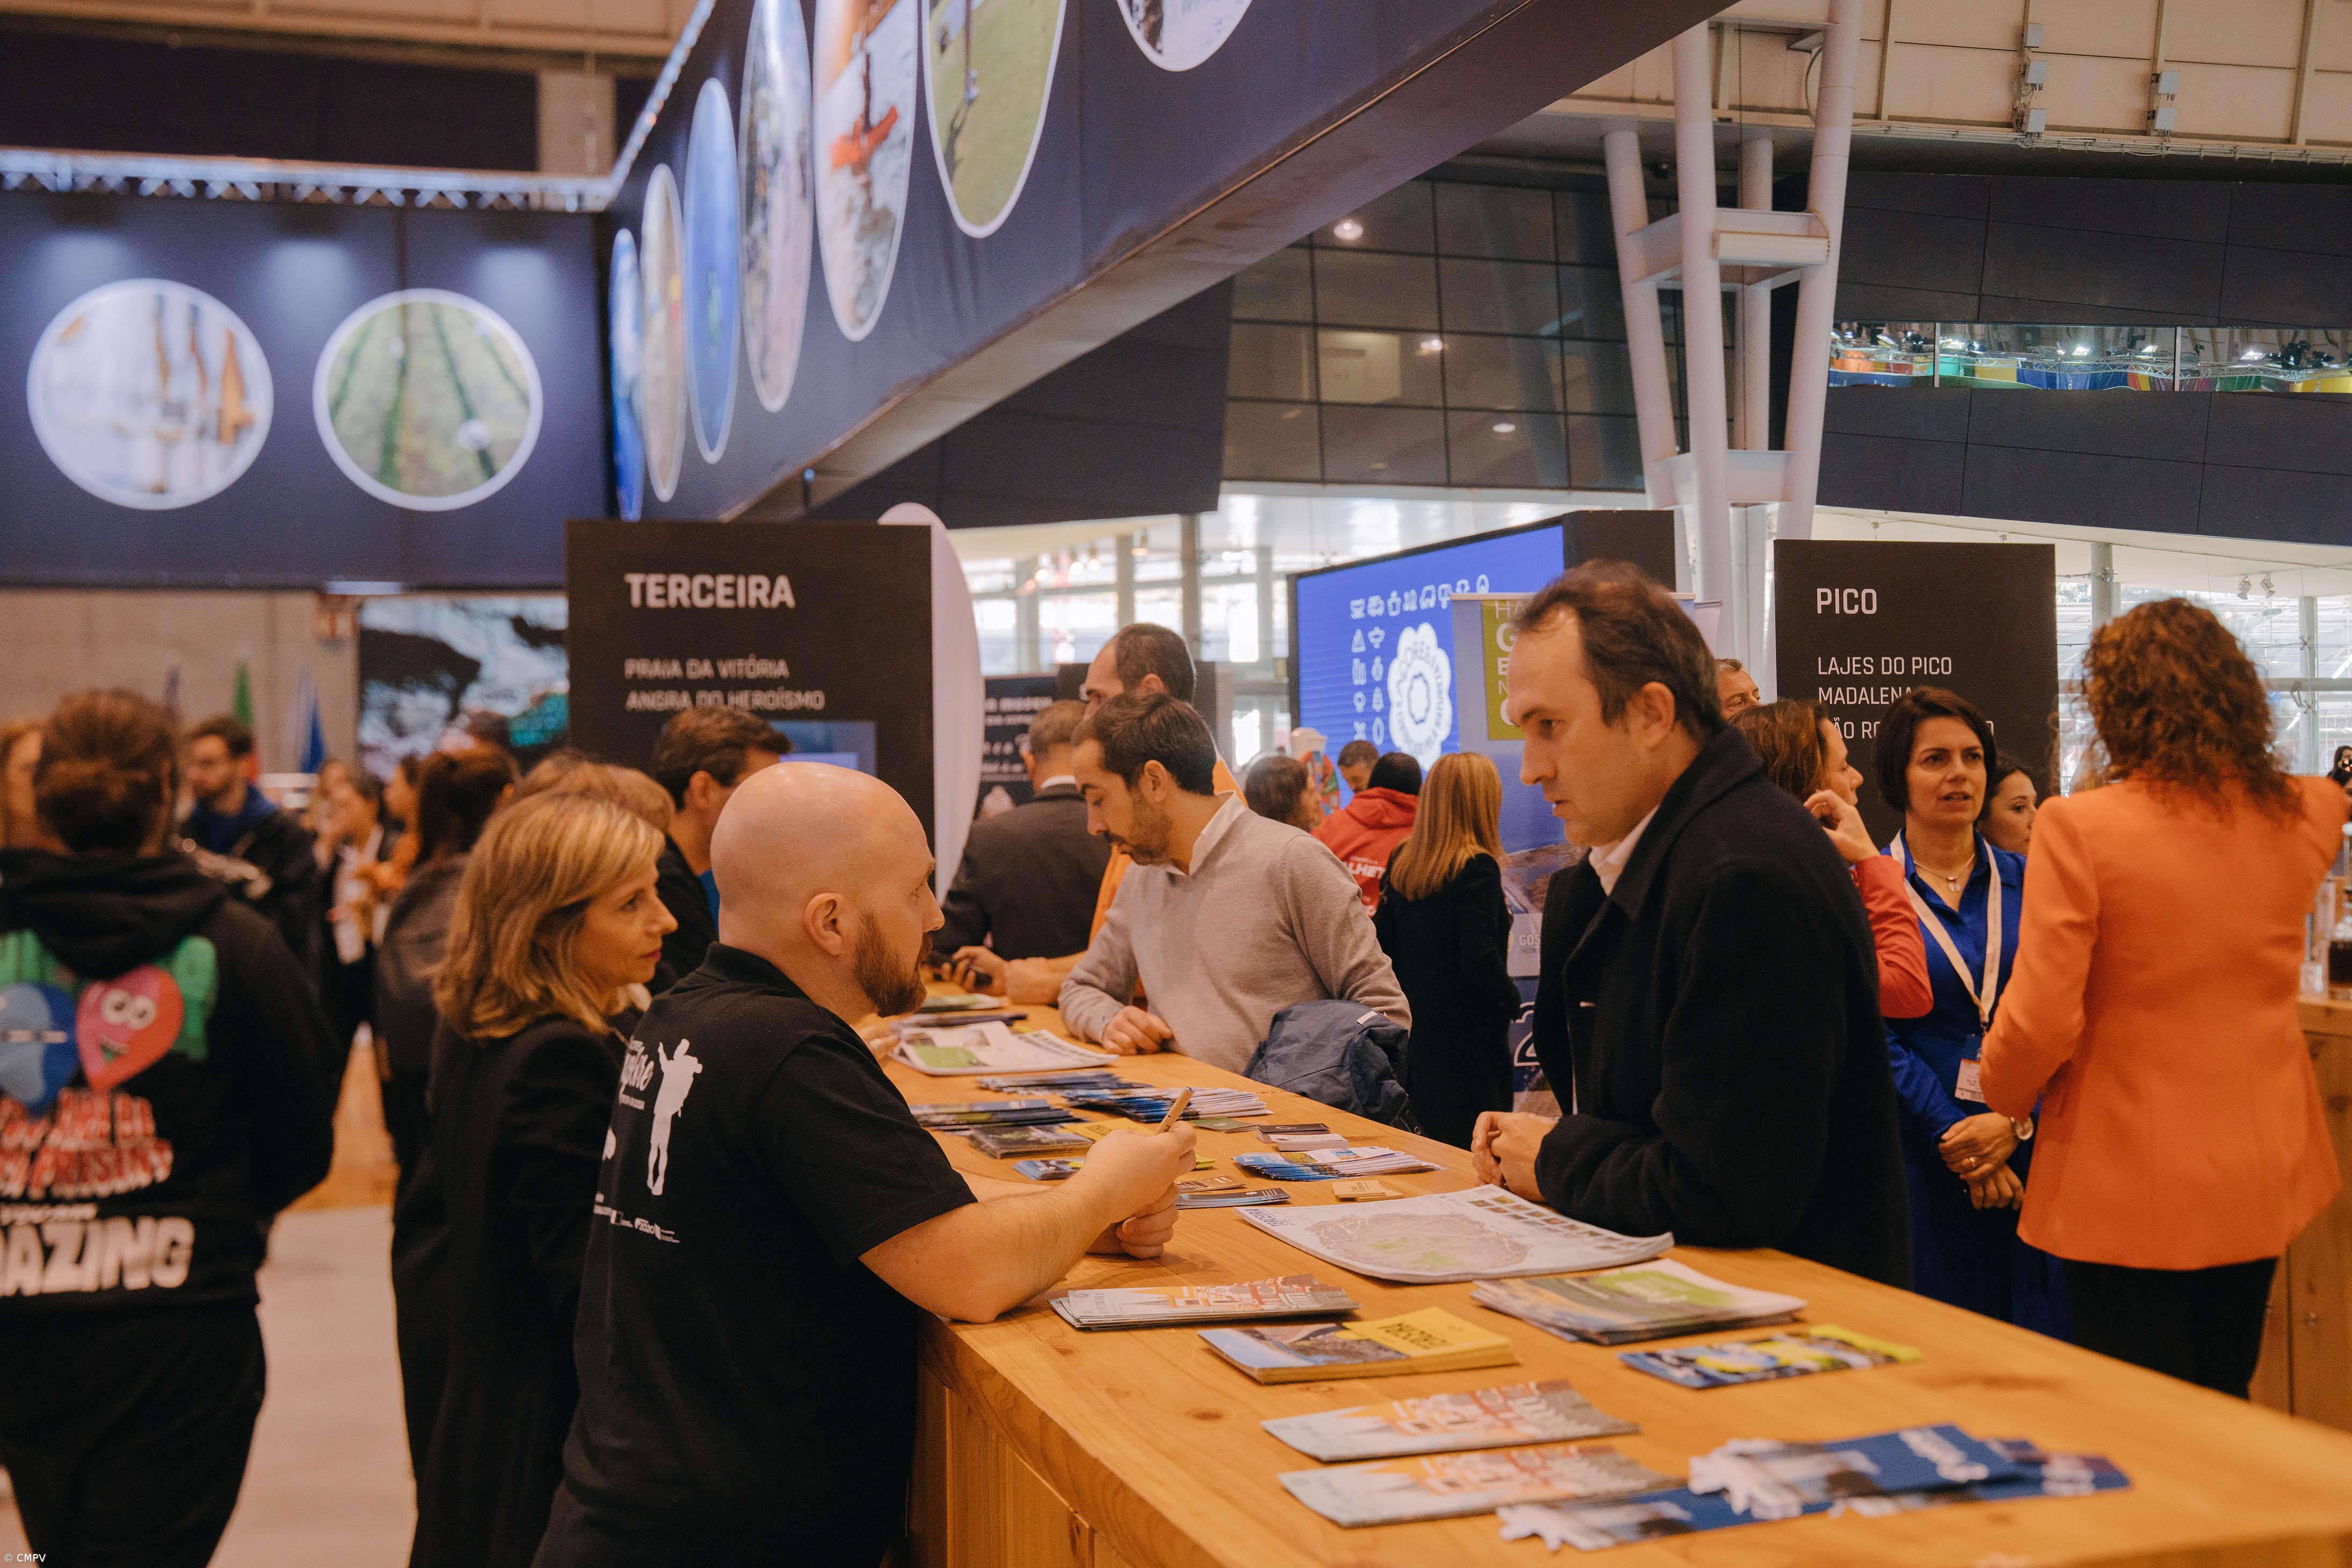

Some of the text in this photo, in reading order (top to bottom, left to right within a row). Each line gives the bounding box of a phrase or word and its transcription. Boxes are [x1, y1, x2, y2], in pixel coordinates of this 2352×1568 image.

[623, 572, 796, 608] TERCEIRA
[1817, 588, 1877, 614] PICO
[624, 654, 790, 679] PRAIA DA VITÓRIA
[1818, 657, 1952, 675] LAJES DO PICO
[625, 685, 825, 712] ANGRA DO HEROÍSMO
[1833, 717, 1855, 739] ÃO
[0, 1216, 195, 1297] AZING
